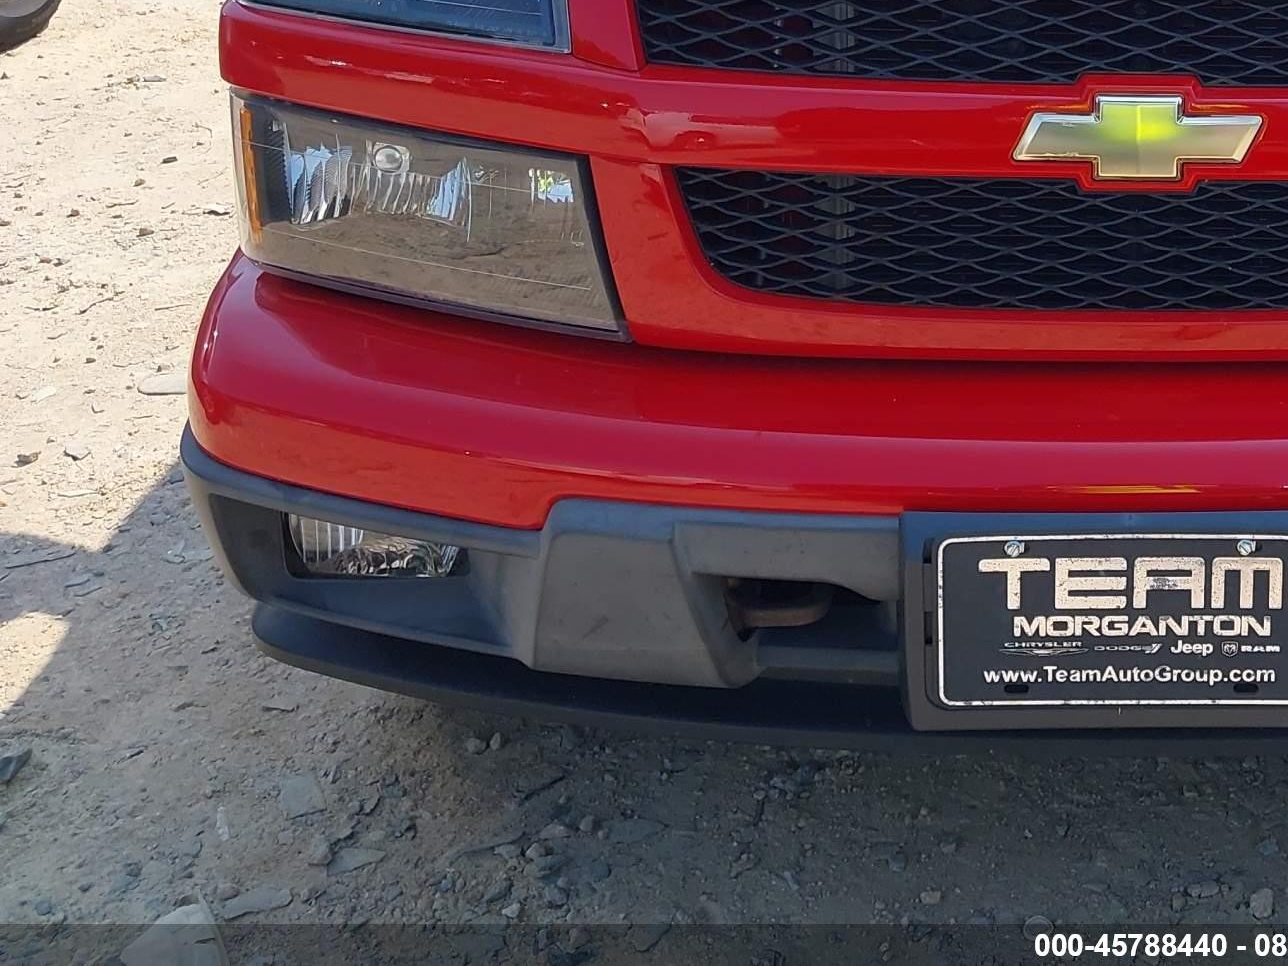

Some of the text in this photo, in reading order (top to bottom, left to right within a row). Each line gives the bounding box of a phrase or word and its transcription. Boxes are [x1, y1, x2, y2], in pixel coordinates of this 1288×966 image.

[977, 556, 1284, 611] TEAM
[1012, 614, 1272, 638] MORGANTON
[1003, 640, 1083, 648] CHRYSLER
[1170, 639, 1214, 657] Jeep
[1240, 644, 1281, 653] RAM
[983, 664, 1277, 686] www.TeamAutoGroup.com
